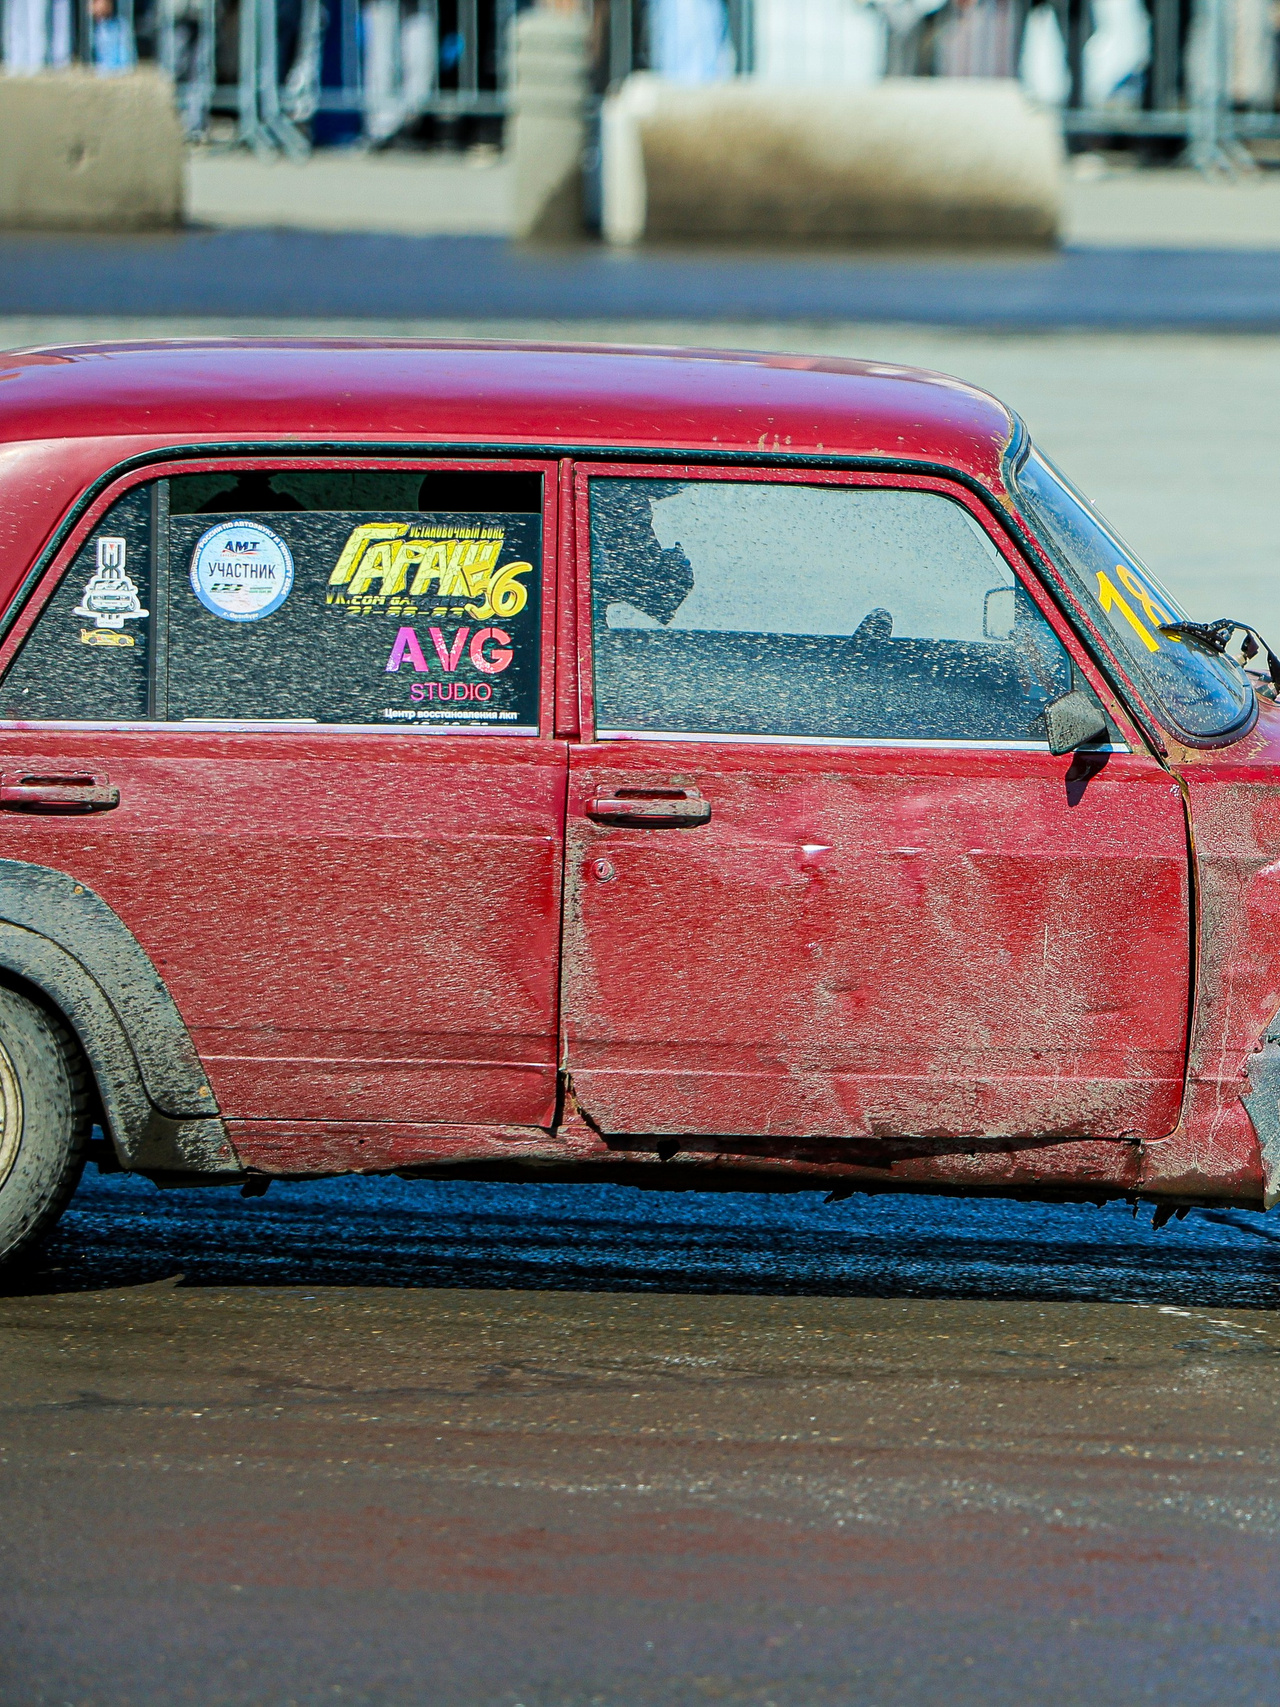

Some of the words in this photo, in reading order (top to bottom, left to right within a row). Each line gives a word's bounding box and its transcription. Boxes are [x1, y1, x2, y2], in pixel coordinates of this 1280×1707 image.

[200, 525, 223, 548] РОССИИ
[222, 521, 234, 529] ПО
[234, 520, 276, 539] АВТОЗВУКУ
[208, 562, 276, 580] УЧАСТНИК
[328, 522, 504, 596] ГАРАЖ
[460, 561, 533, 620] 56
[384, 626, 514, 674] AVG
[410, 682, 492, 701] STUDIO
[384, 707, 416, 720] Центр
[416, 711, 498, 720] восстановления
